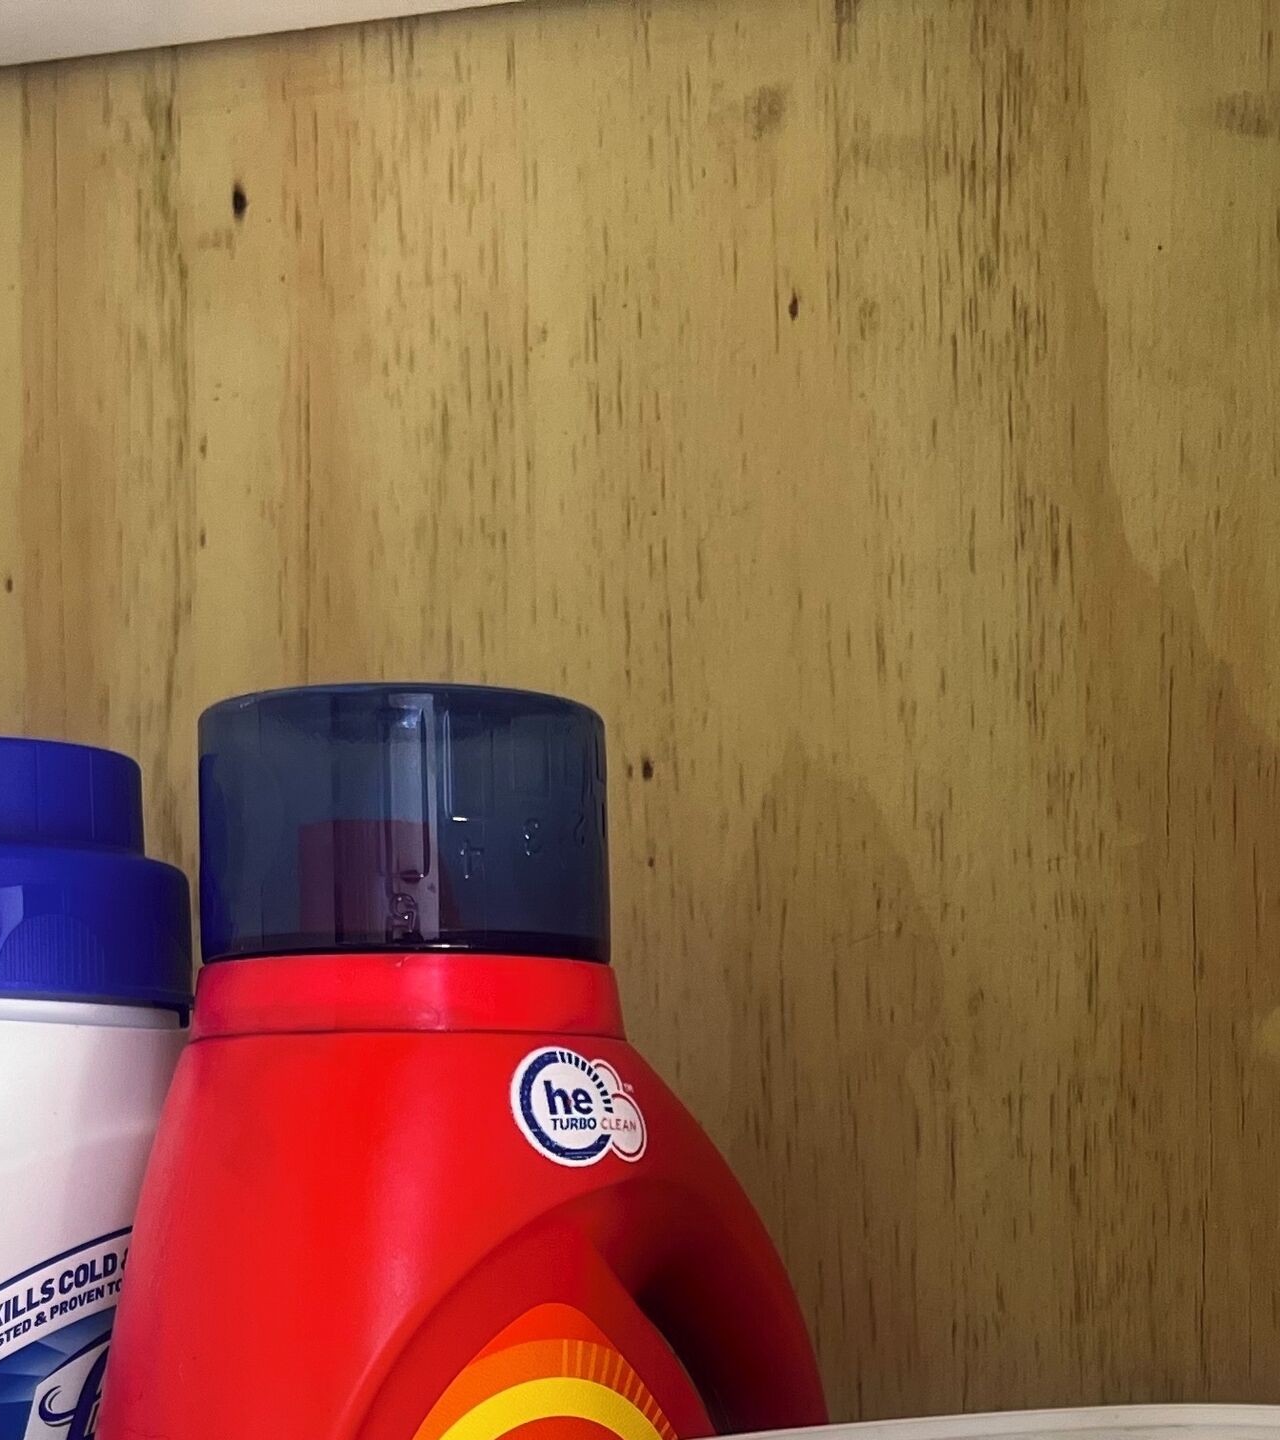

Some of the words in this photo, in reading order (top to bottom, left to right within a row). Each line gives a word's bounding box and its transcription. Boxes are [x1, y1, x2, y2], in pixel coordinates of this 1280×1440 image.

[543, 1080, 593, 1115] he
[550, 1118, 597, 1131] TURBO
[600, 1118, 637, 1132] CLEAN
[58, 1252, 118, 1295] COLD
[33, 1310, 47, 1328] &
[49, 1285, 105, 1322] PROVEN
